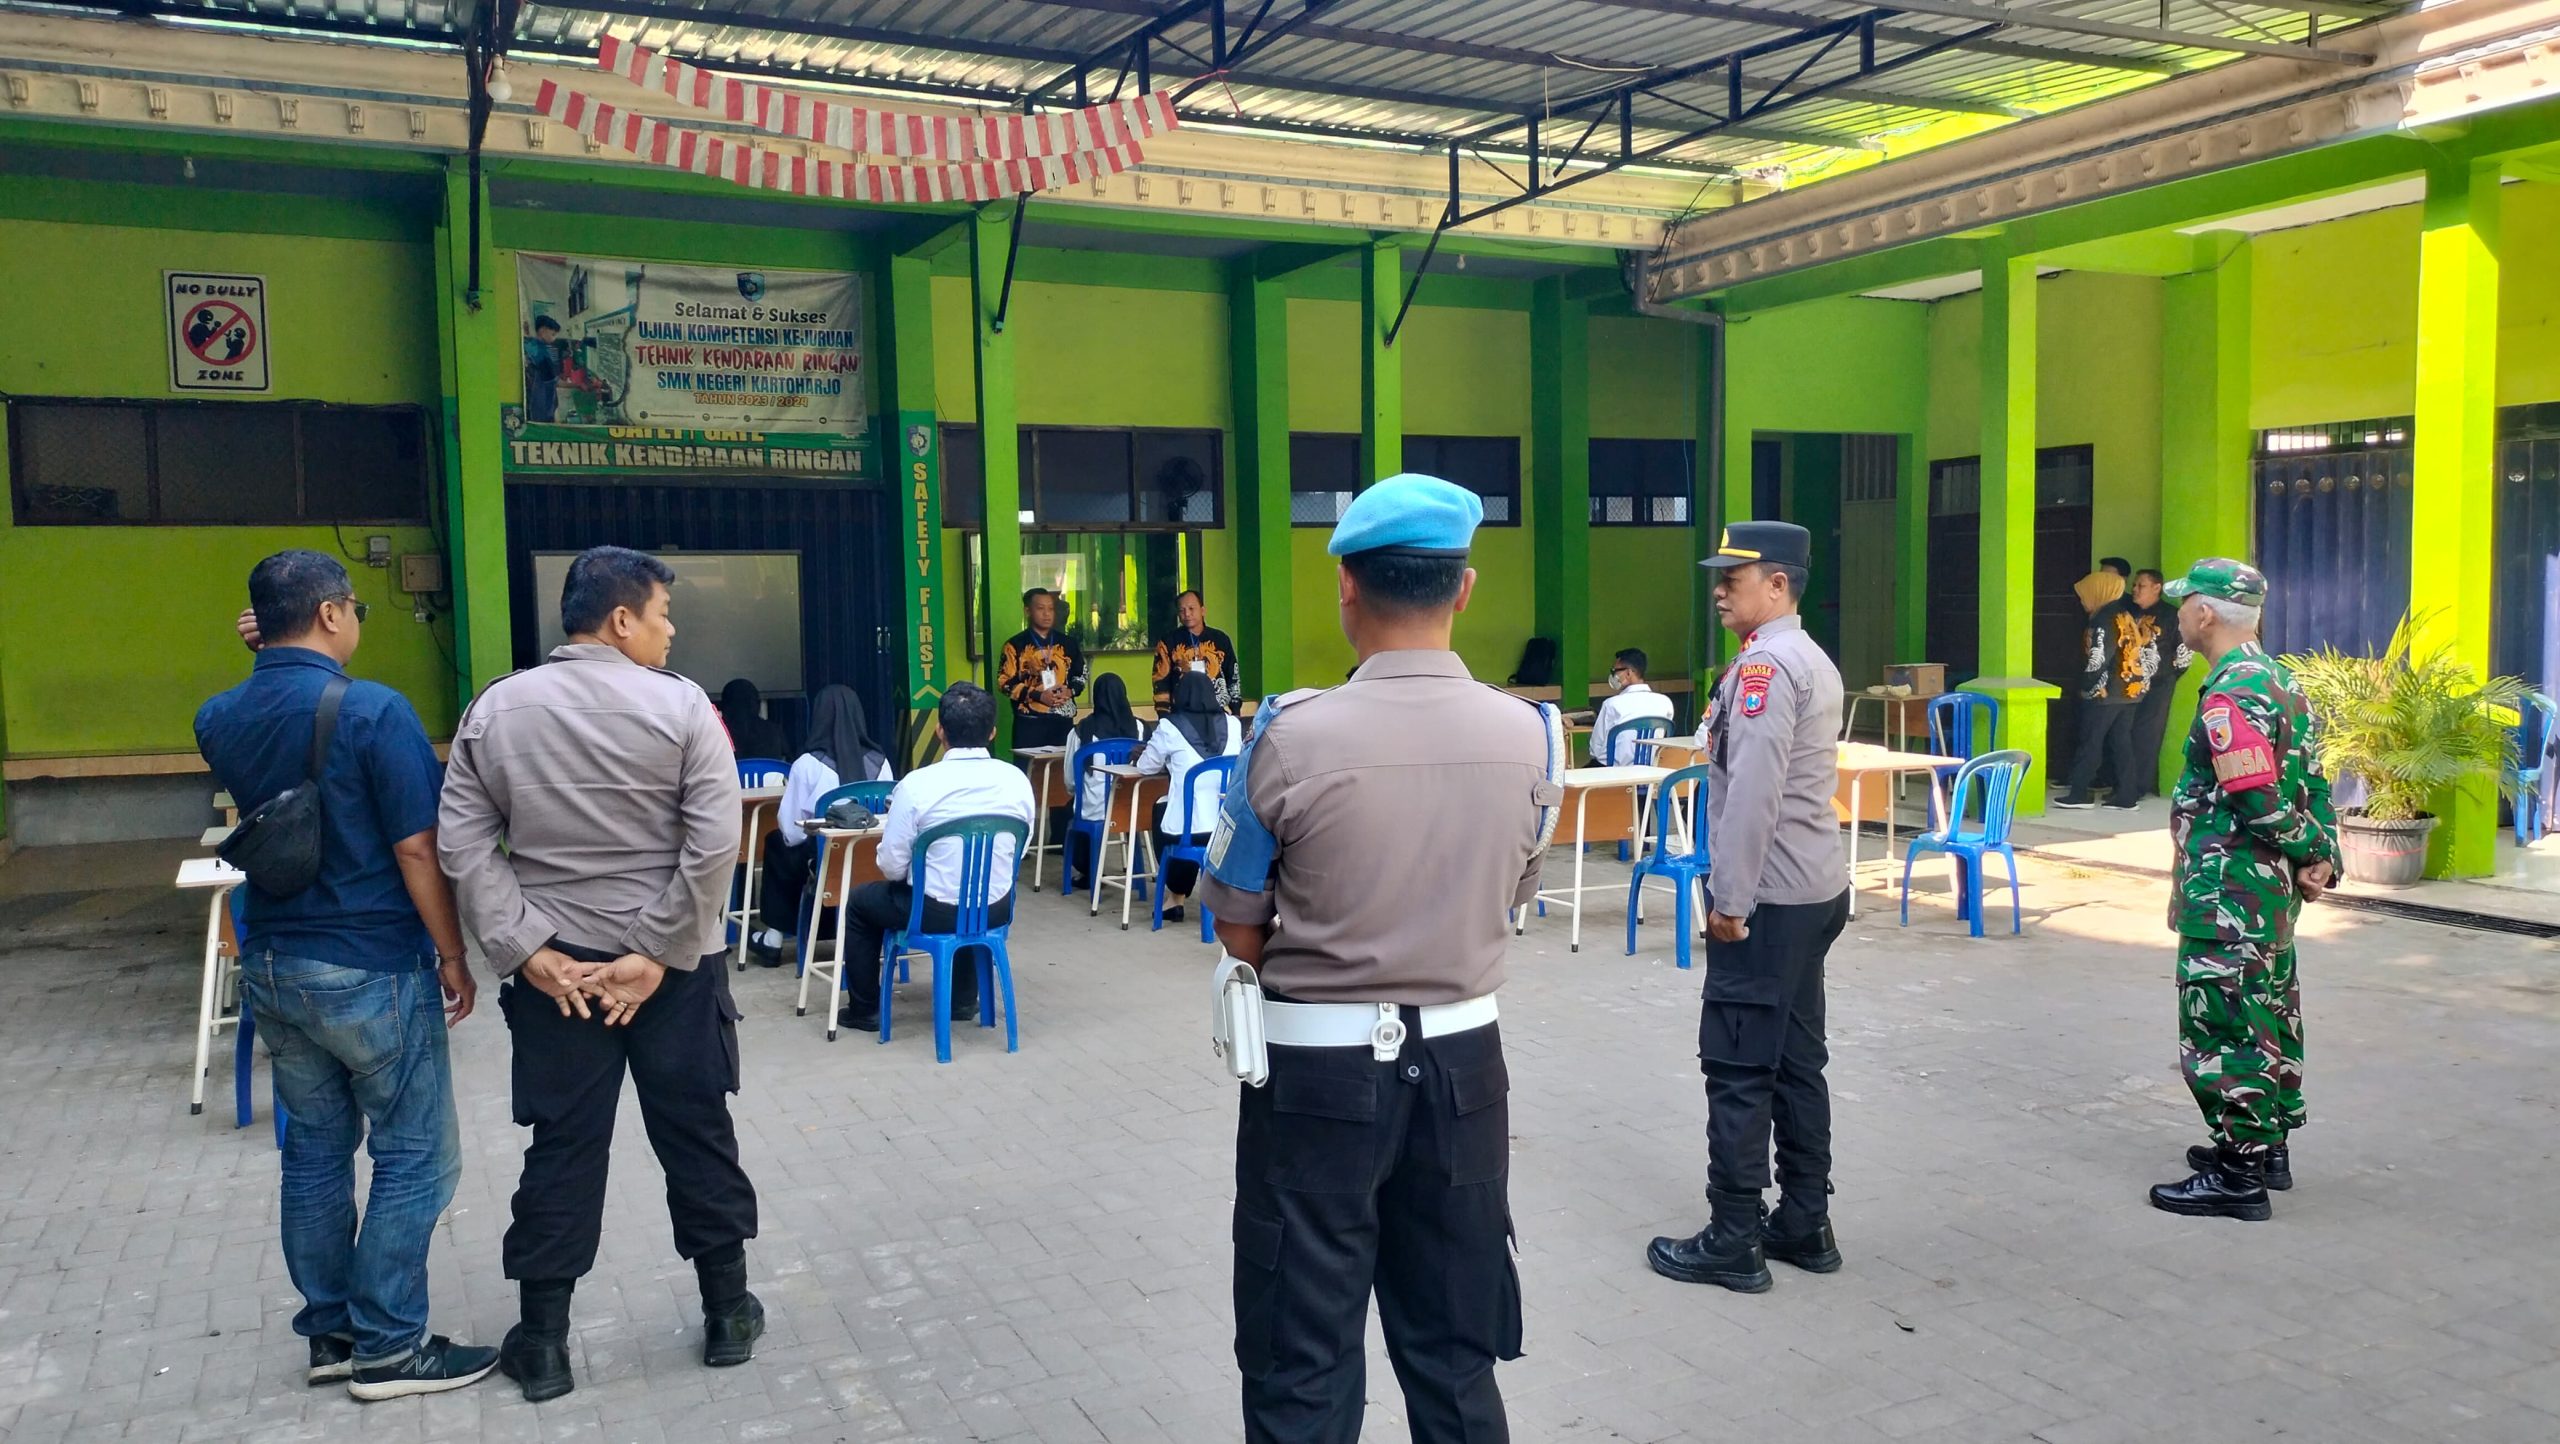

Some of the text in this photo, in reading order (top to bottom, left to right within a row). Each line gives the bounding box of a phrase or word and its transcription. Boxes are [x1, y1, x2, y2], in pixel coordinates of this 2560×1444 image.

[176, 284, 257, 297] NO BULLY
[675, 302, 827, 323] Selamat & Sukses
[638, 321, 683, 340] UJIAN
[687, 324, 779, 345] KOMPETENSI
[783, 328, 853, 348] KEJURUAN
[635, 345, 859, 374] TEHNIK KENDARAAN RINGAN
[197, 370, 244, 382] ZONE
[657, 371, 841, 395] SMK NEGERI KARTOHARJO
[694, 393, 735, 406] TAHUN
[737, 395, 769, 407] 2023
[777, 396, 809, 408] 2024
[510, 441, 862, 472] TEKNIK KENDARAAN RINGAN
[913, 461, 934, 681] SAFETY FIRST
